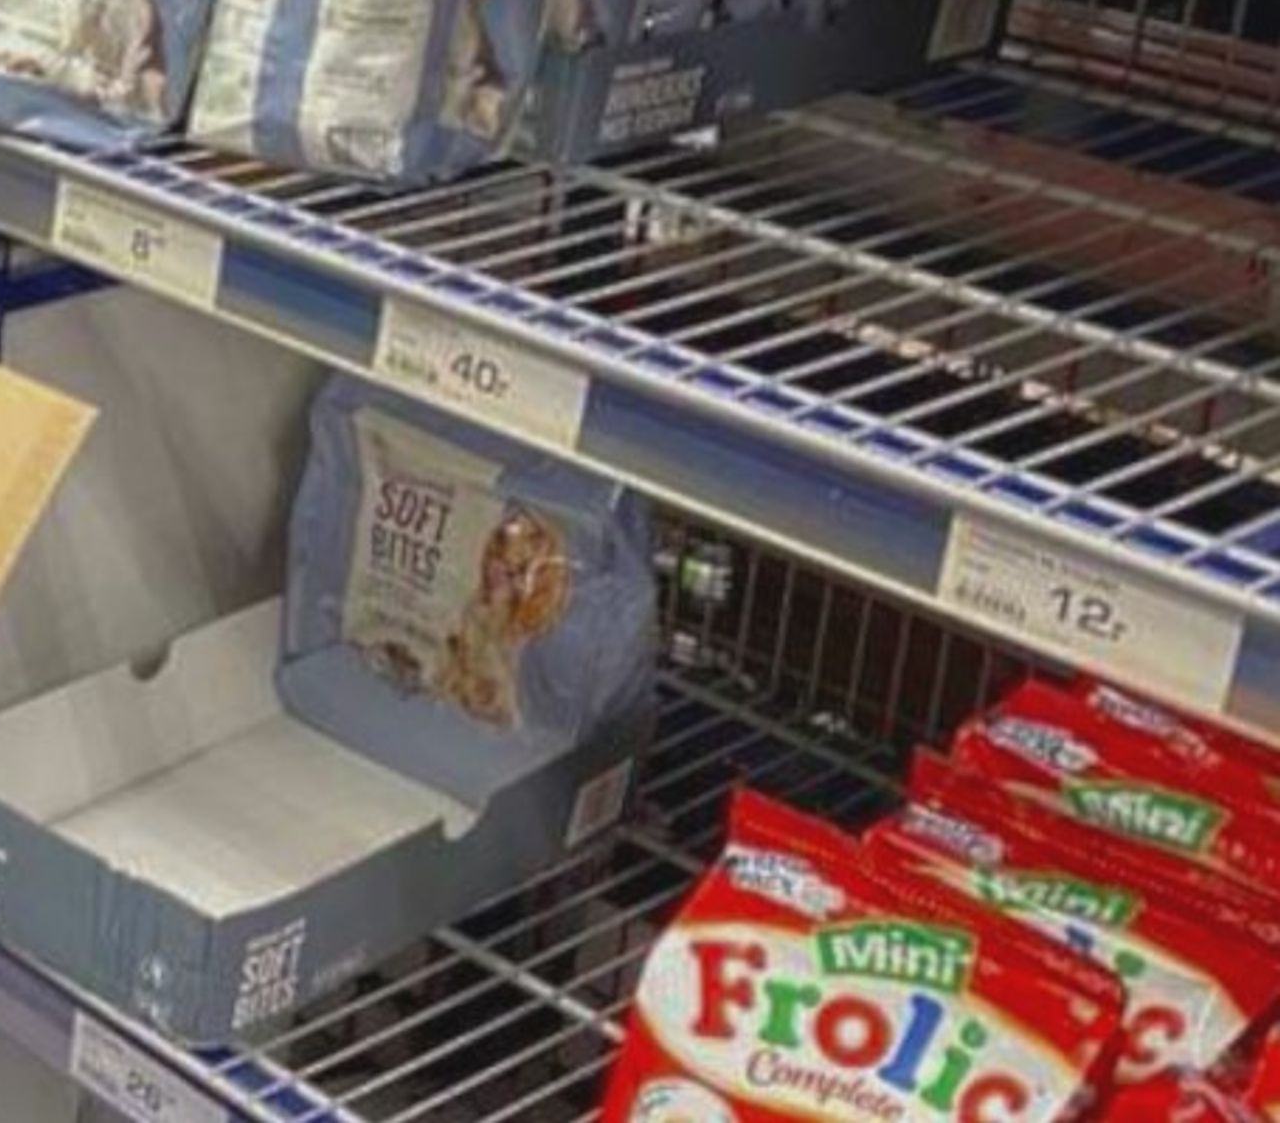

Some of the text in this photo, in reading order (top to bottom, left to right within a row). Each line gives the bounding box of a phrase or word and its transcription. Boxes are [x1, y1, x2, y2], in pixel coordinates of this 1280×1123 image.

[375, 478, 452, 542] SOFT
[369, 523, 441, 582] BITES
[240, 932, 307, 993] SOFT
[827, 929, 956, 986] Mini
[231, 977, 296, 1029] BITES
[690, 939, 1029, 1123] Frolic
[745, 1047, 904, 1120] Complete
